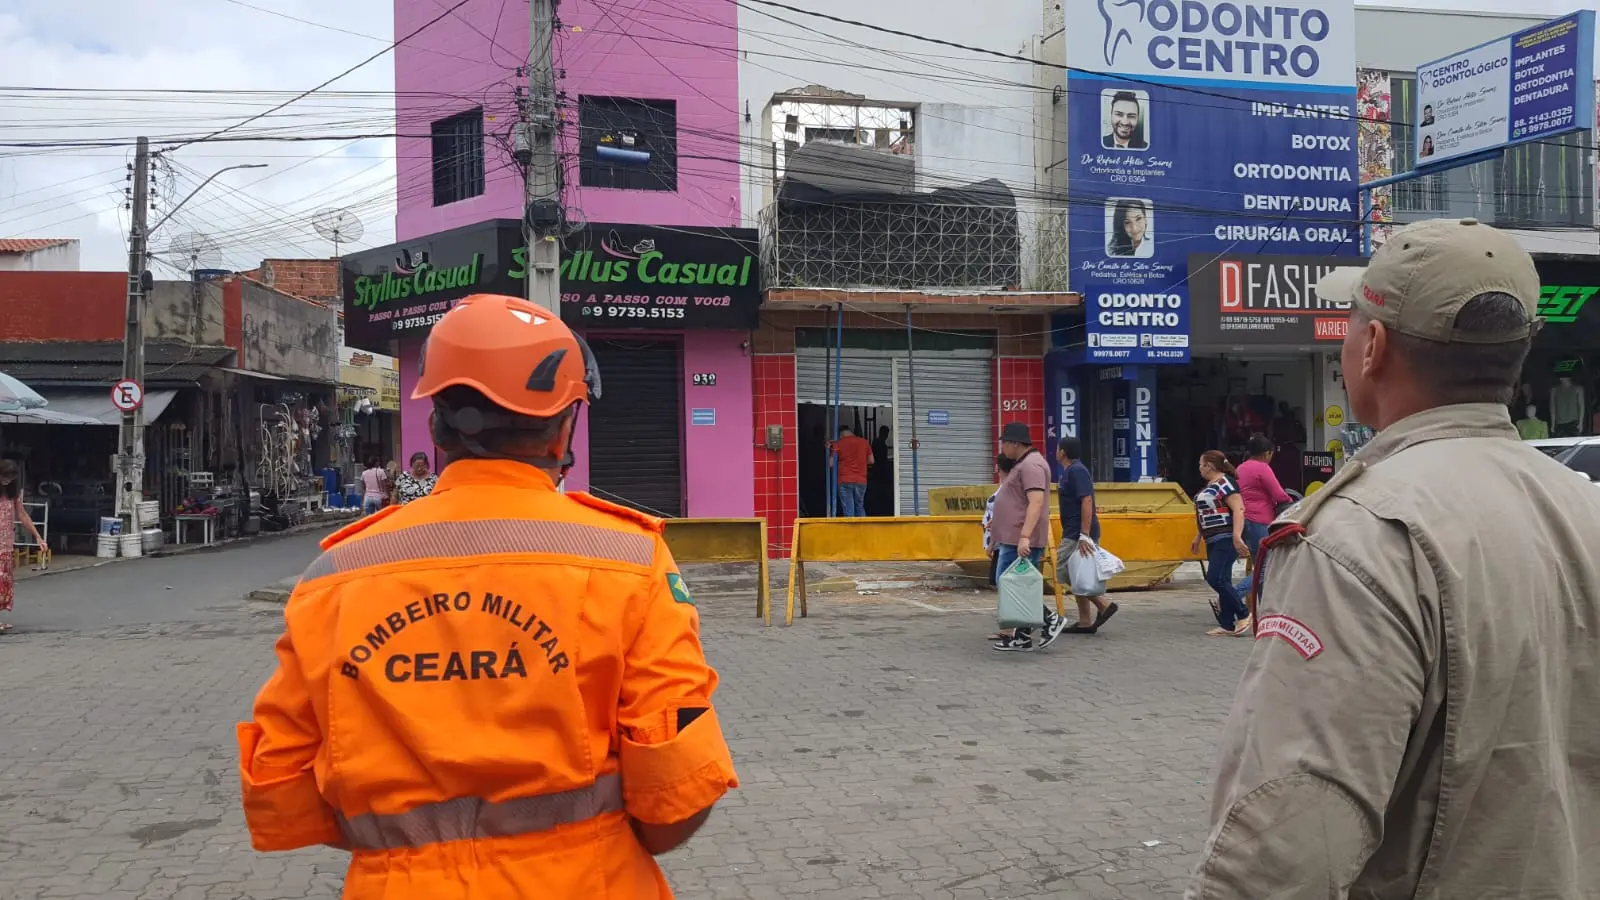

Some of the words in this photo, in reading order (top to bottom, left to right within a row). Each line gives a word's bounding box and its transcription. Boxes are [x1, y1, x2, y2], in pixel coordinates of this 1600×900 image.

[1147, 0, 1329, 42] ODONTO
[1147, 35, 1320, 78] CENTRO
[1515, 45, 1565, 67] IMPLANTES
[1432, 57, 1508, 88] ODONTOLÓGICO
[1433, 59, 1469, 78] CENTRO
[1515, 64, 1545, 80] BOTOX
[1514, 68, 1574, 92] ORTODONTIA
[1514, 83, 1568, 105] DENTADURA
[1252, 102, 1350, 120] IMPLANTES
[1292, 134, 1351, 151] BOTOX
[1233, 163, 1352, 182] ORTODONTIA
[1243, 194, 1352, 212] DENTADURA
[1214, 225, 1300, 242] CIRURGIA
[1305, 228, 1352, 243] ORAL
[637, 250, 752, 286] Casual
[353, 272, 411, 311] Styllus
[414, 252, 479, 295] Casual
[583, 293, 597, 303] A
[603, 294, 650, 304] PASSO
[655, 295, 688, 305] COM
[694, 295, 731, 307] VOCÊ
[1098, 293, 1181, 308] ODONTO
[368, 310, 392, 323] PASSO
[394, 309, 400, 317] A
[402, 305, 426, 316] PASSO
[429, 300, 447, 311] COM
[593, 307, 603, 317] 9
[608, 307, 685, 319] 9739.5153
[1098, 311, 1179, 327] CENTRO
[122, 387, 133, 403] E
[1003, 400, 1027, 411] 928
[340, 591, 471, 680] BOMBEIRO
[481, 592, 570, 675] MILITAR
[1279, 620, 1315, 652] MILITAR
[384, 641, 528, 683] CEARÁ
